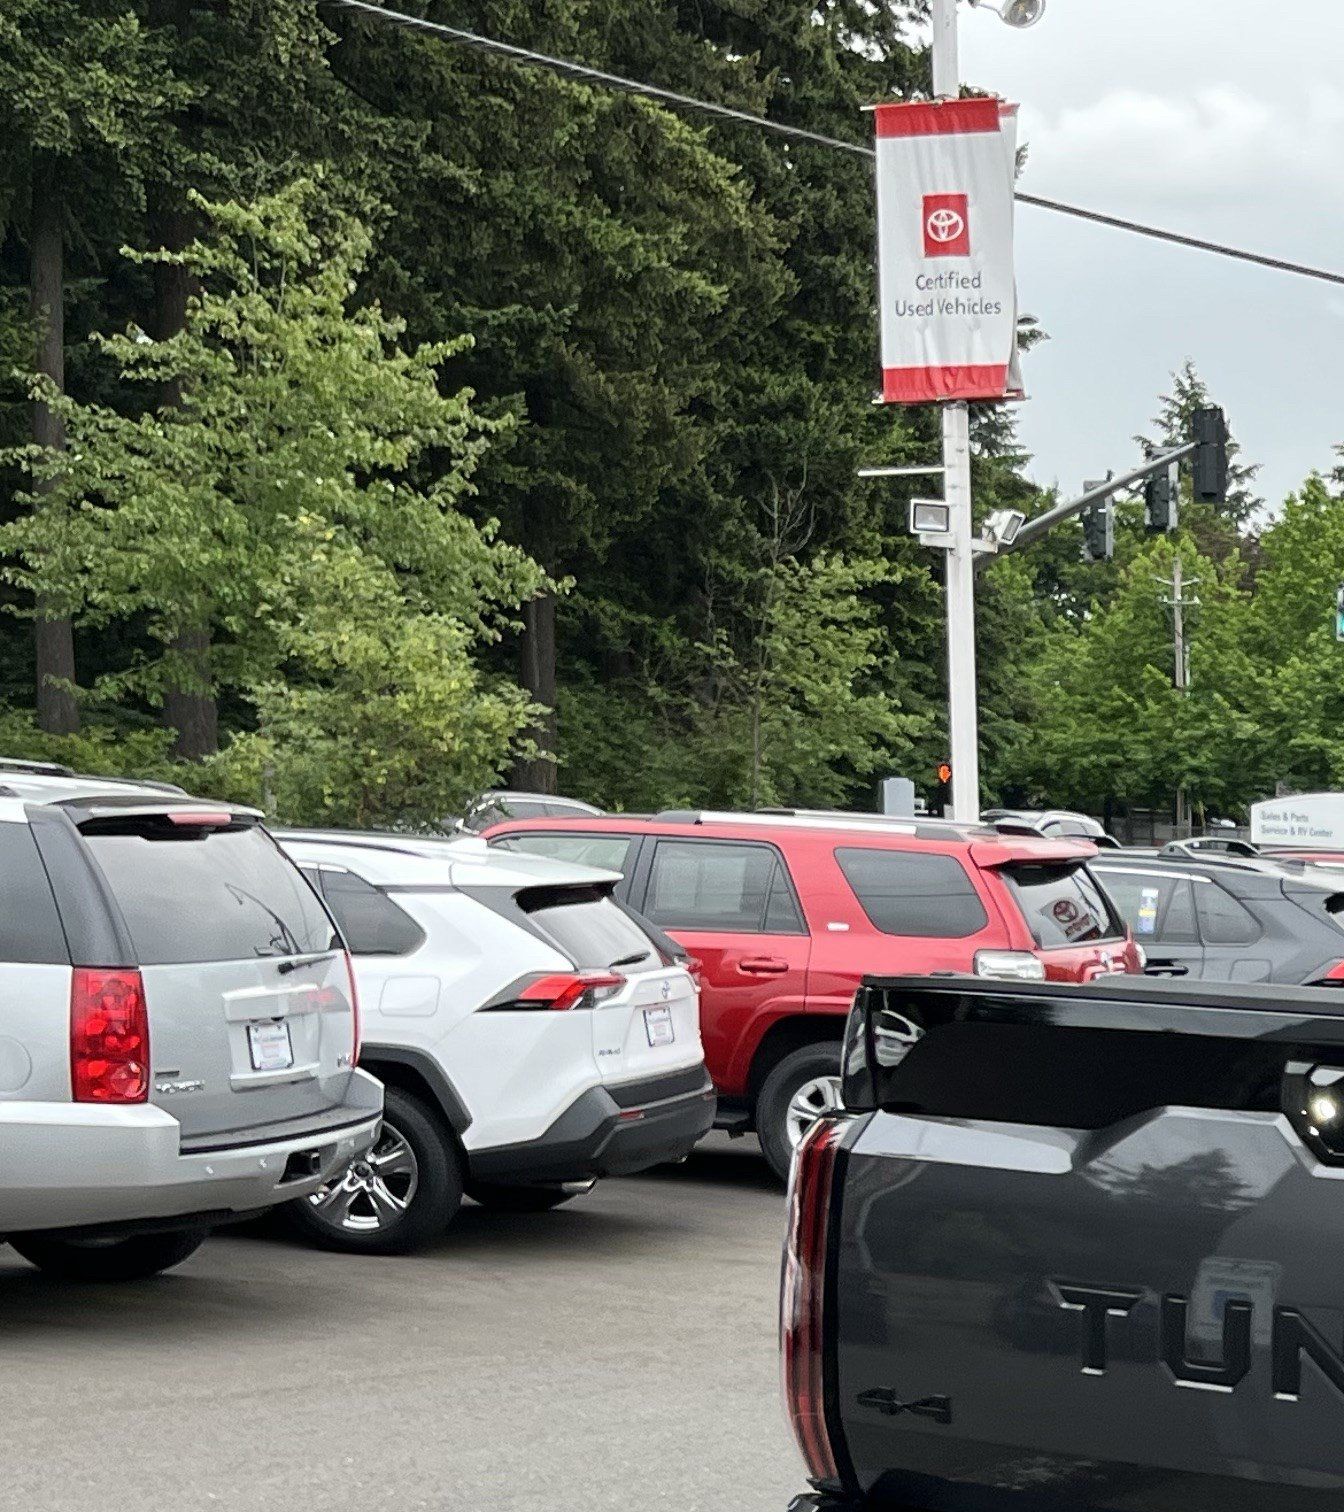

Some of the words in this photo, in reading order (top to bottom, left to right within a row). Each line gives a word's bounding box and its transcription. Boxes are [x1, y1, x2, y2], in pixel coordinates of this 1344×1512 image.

[916, 271, 981, 290] Certified
[896, 300, 934, 317] Used
[937, 297, 1001, 316] Vehicles
